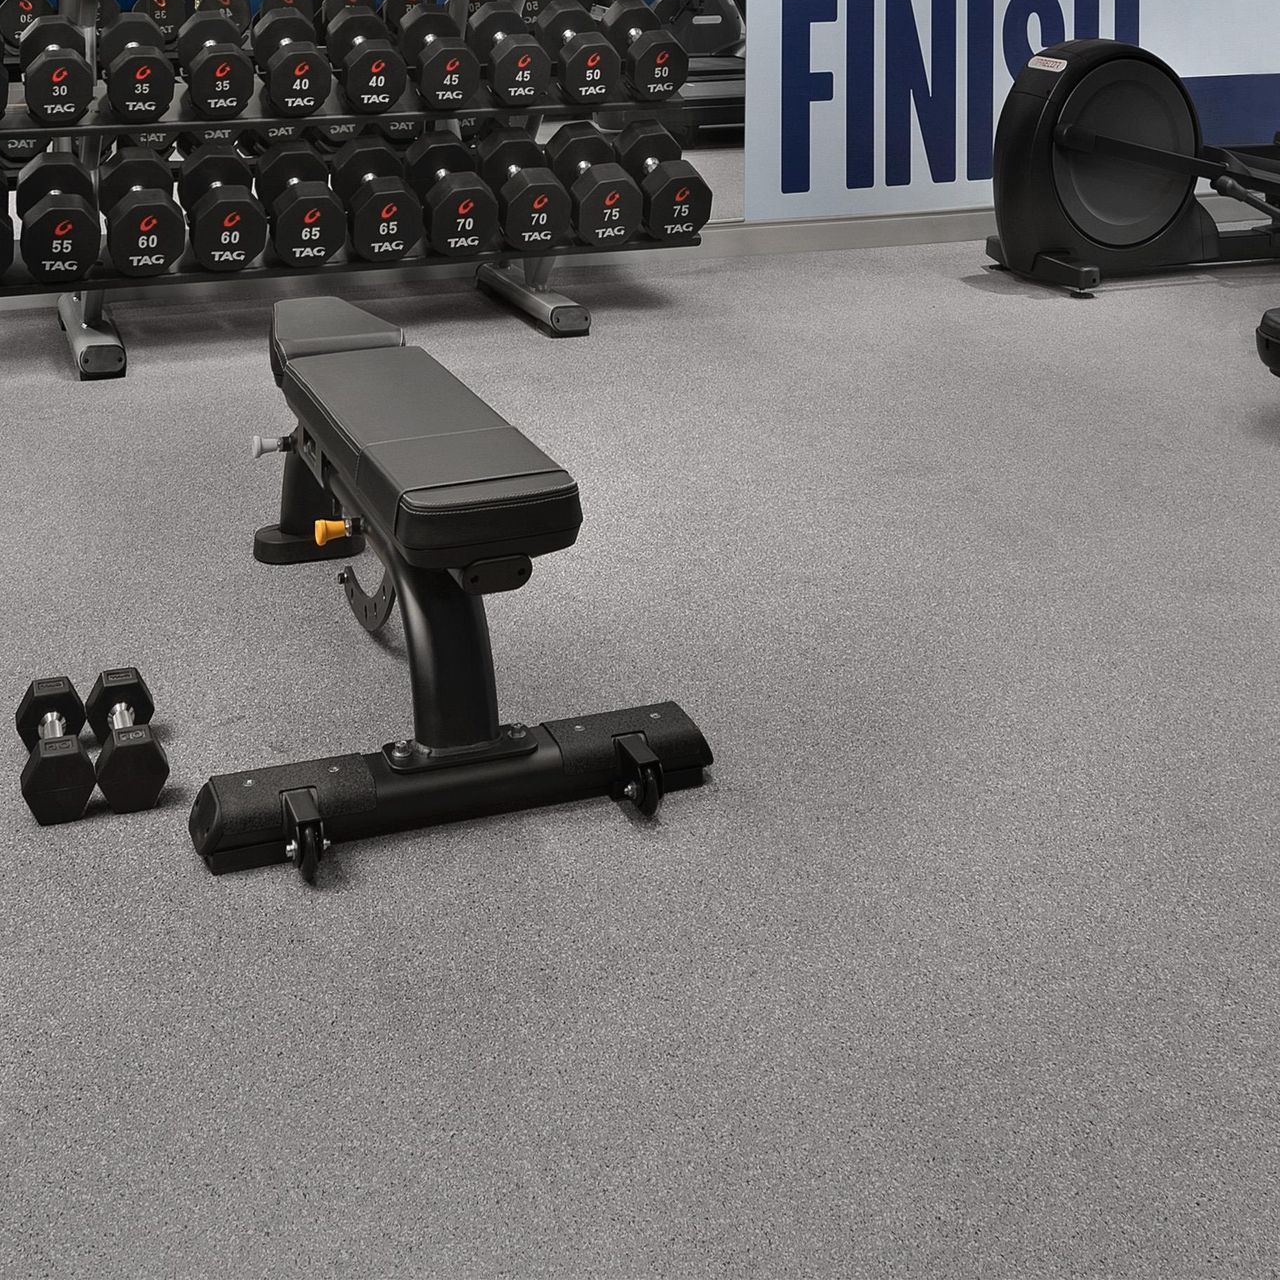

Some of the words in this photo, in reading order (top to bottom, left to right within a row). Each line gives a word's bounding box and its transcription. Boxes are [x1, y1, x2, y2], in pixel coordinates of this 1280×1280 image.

[515, 70, 531, 82] 45
[585, 68, 601, 81] 50
[654, 66, 669, 78] 50
[215, 80, 230, 92] 35
[292, 78, 310, 91] 40
[368, 75, 385, 88] 40
[443, 74, 460, 86] 45
[52, 85, 68, 97] 30
[134, 83, 150, 94] 35
[507, 86, 535, 97] TAG
[578, 84, 606, 96] TAG
[647, 82, 674, 94] TAG
[360, 93, 390, 104] TAG
[435, 90, 463, 100] TAG
[125, 101, 156, 111] TAG
[207, 97, 238, 108] TAG
[284, 96, 315, 107] TAG
[43, 103, 76, 114] TAG
[603, 207, 620, 222] 75
[673, 204, 690, 218] 75
[456, 217, 474, 232] 70
[531, 212, 548, 226] 70
[301, 226, 321, 241] 65
[379, 221, 398, 235] 65
[595, 225, 625, 239] TAG
[664, 222, 694, 235] TAG
[138, 234, 158, 249] 60
[220, 230, 240, 244] 60
[447, 236, 480, 248] TAG
[521, 230, 552, 242] TAG
[52, 239, 73, 253] 55
[291, 246, 326, 258] TAG
[370, 240, 404, 253] TAG
[128, 254, 165, 267] TAG
[210, 250, 246, 262] TAG
[41, 260, 78, 271] TAG
